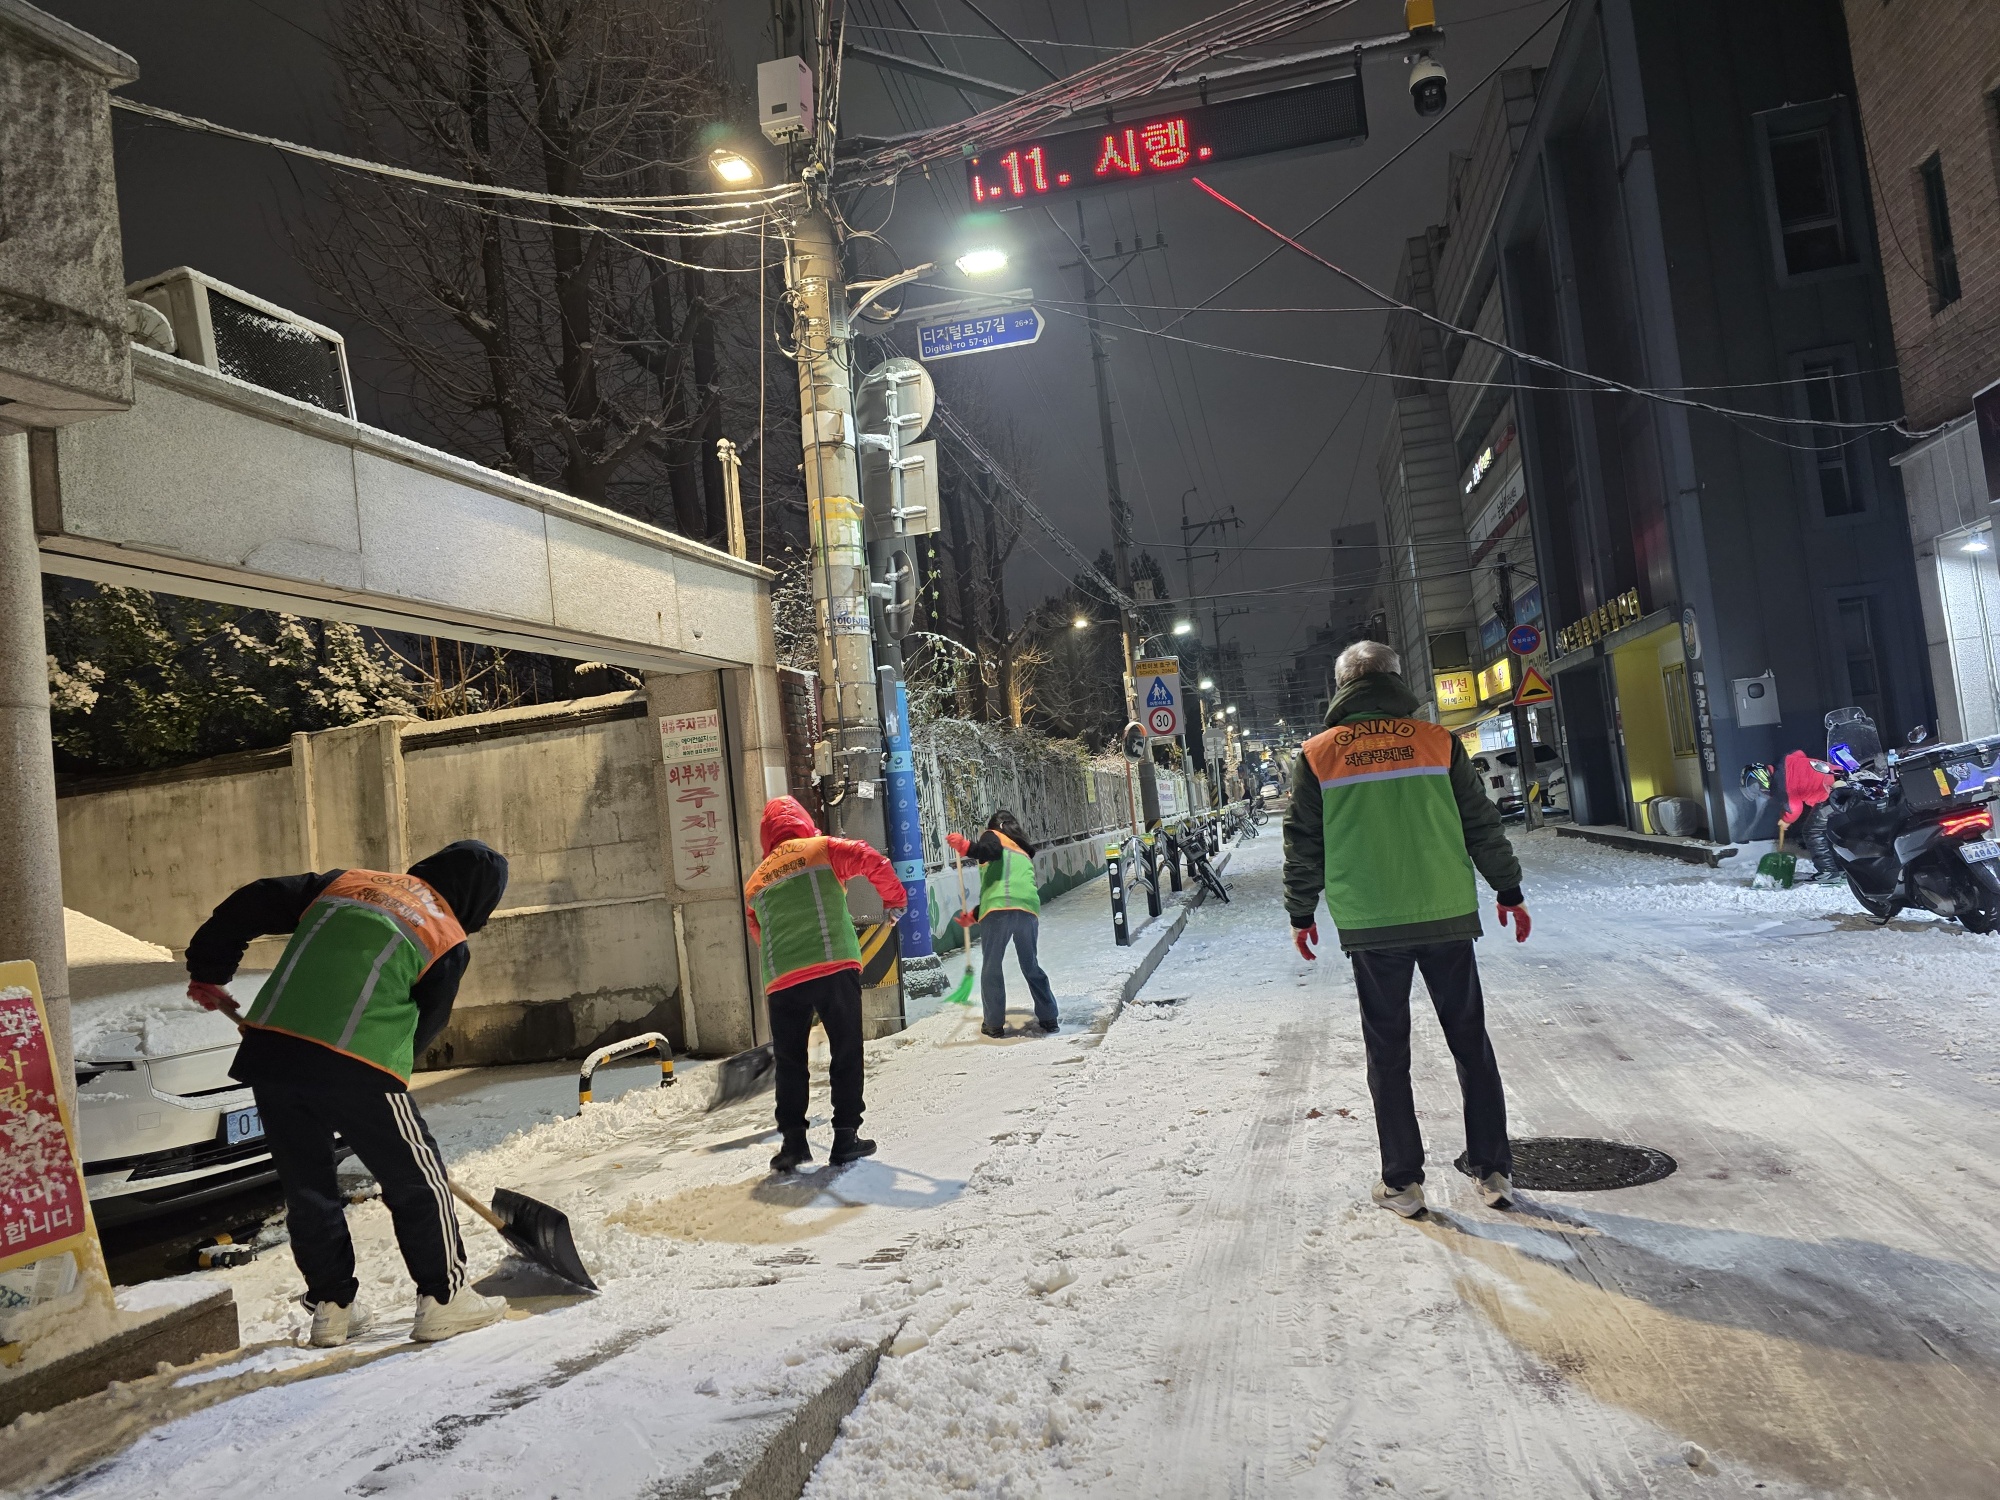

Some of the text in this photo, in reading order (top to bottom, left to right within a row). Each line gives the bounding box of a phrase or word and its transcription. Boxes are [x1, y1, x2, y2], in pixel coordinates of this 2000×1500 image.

[1097, 118, 1213, 174] 시행.
[923, 317, 1006, 343] 디지털로57길
[925, 335, 994, 354] Digital-ro 57-gil
[1136, 661, 1177, 670] 어린이보호구역
[1441, 676, 1469, 695] 패션
[1156, 714, 1169, 728] 30
[1334, 719, 1415, 746] GAIND
[1355, 736, 1396, 750] 영등포구
[1345, 746, 1414, 767] 자율방재단
[669, 761, 721, 787] 외부차량
[0, 1205, 73, 1247] 합니다
